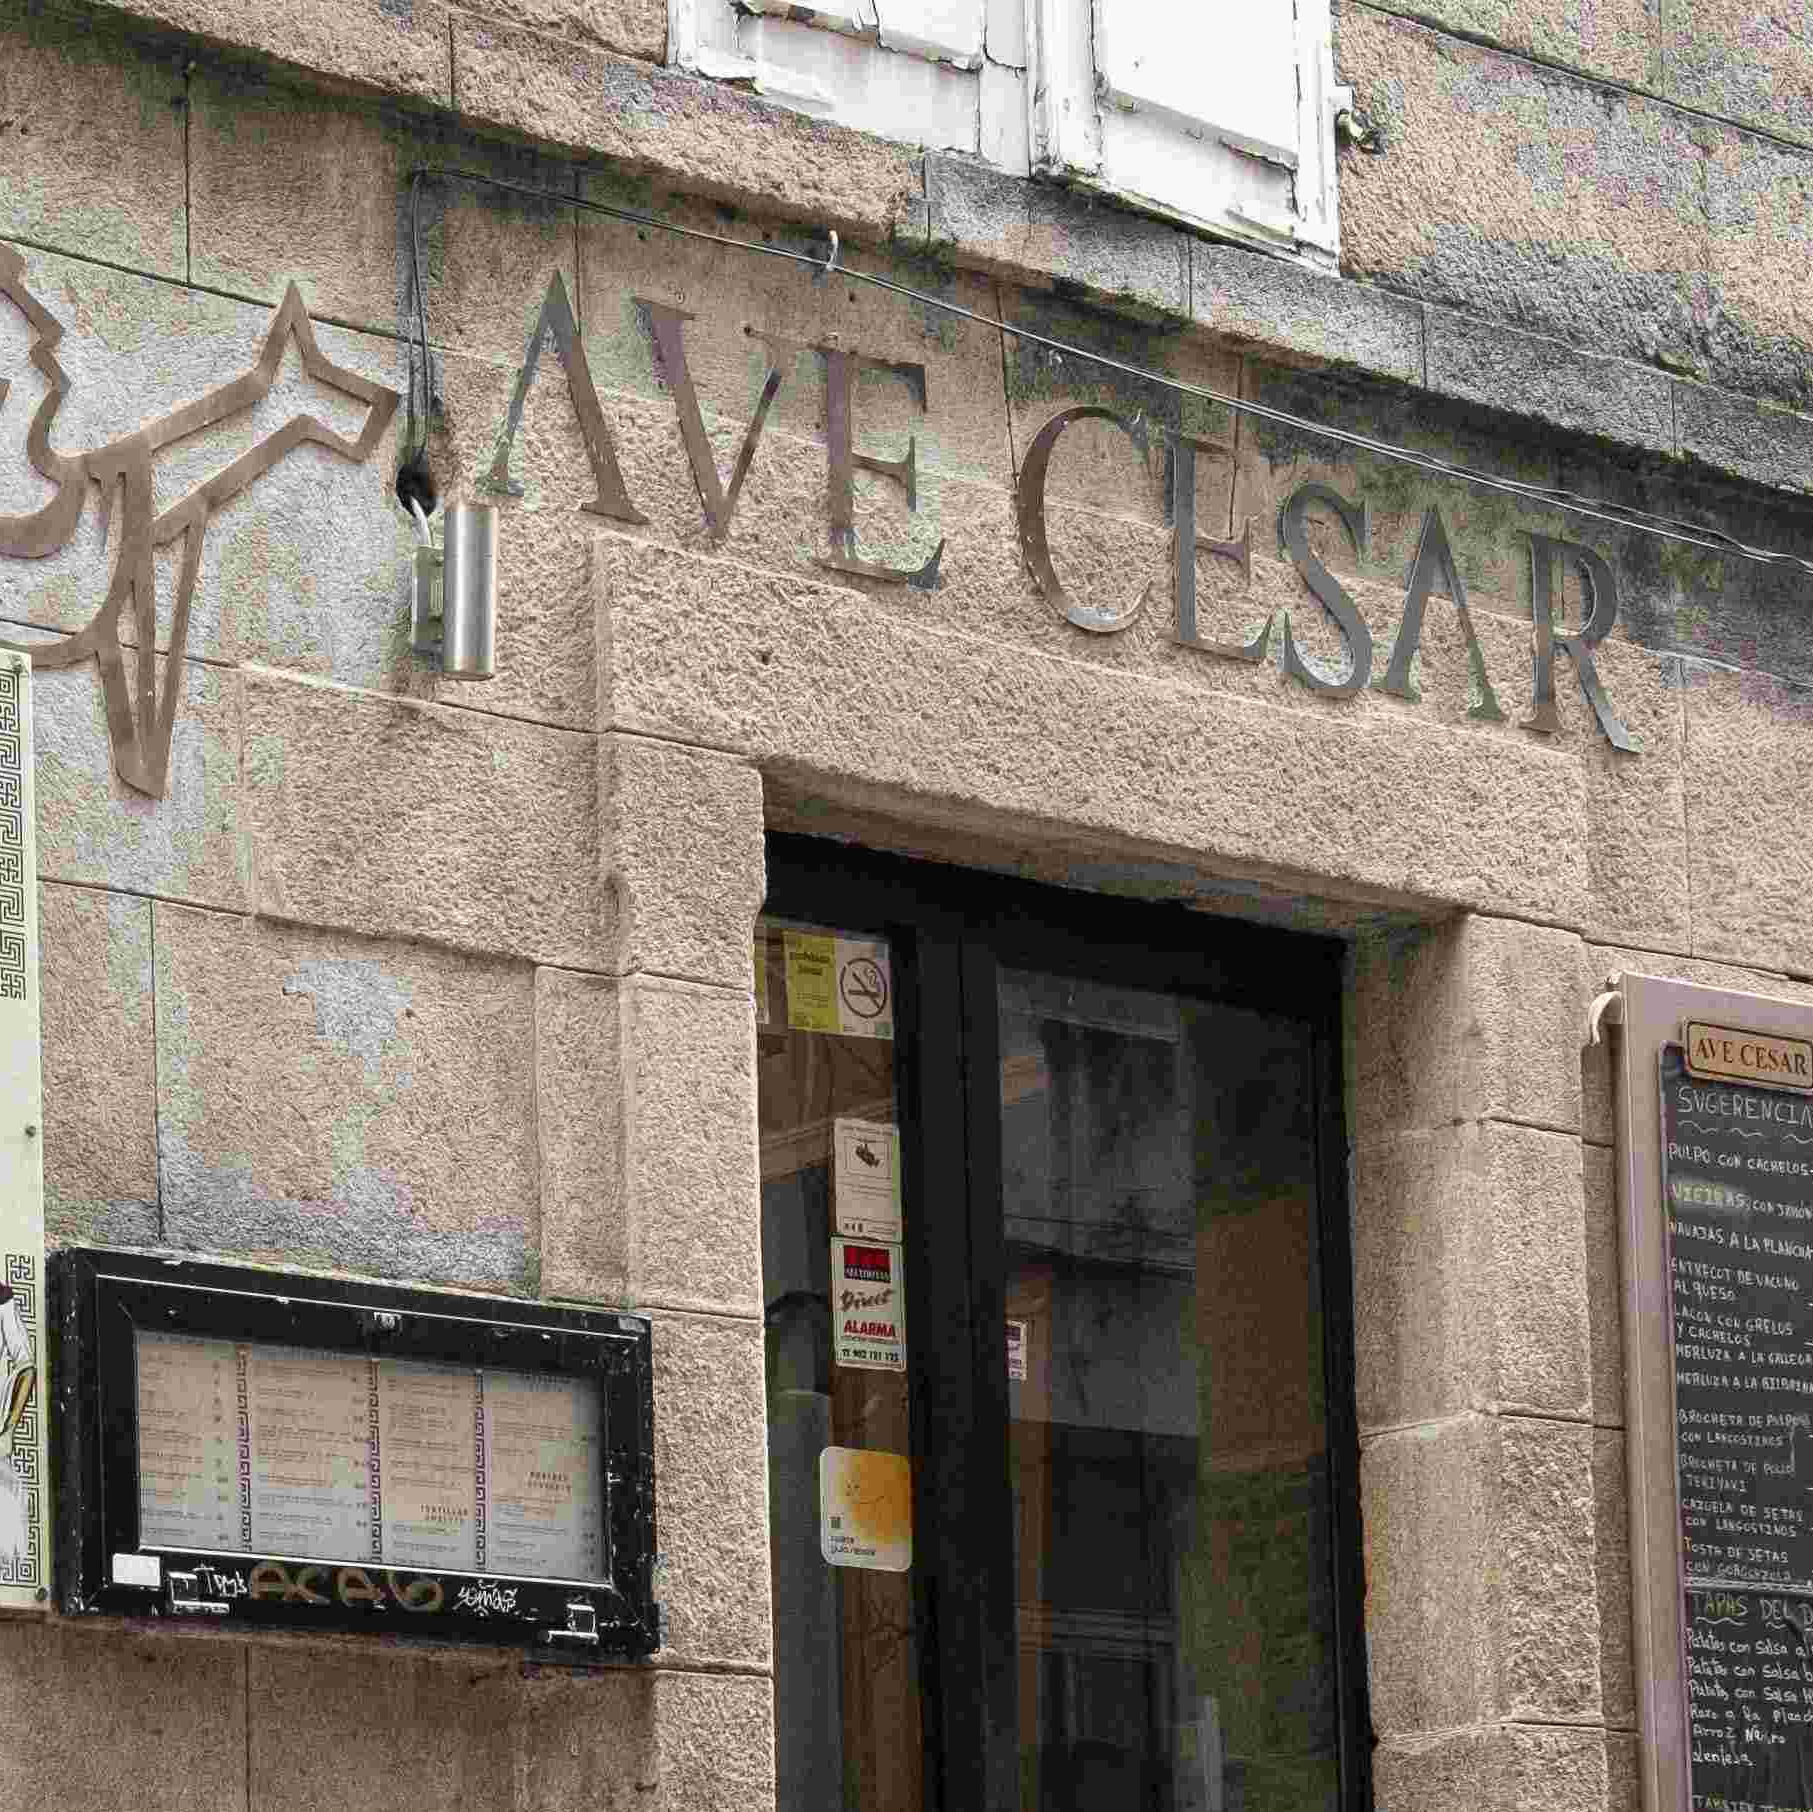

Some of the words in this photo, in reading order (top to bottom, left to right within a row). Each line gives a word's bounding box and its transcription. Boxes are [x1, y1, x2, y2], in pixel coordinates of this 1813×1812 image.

[475, 267, 944, 590] AVE
[1016, 401, 1644, 755] CESAR
[1696, 1038, 1733, 1064] AVE
[1740, 1043, 1807, 1075] CESAR
[1668, 1142, 1710, 1164] PULPO
[1717, 1154, 1741, 1168] CON
[1729, 1232, 1739, 1248] A
[1744, 1235, 1761, 1253] LA
[1738, 1270, 1755, 1285] DE
[844, 1319, 896, 1337] ALARMA
[1760, 1599, 1789, 1621] DEL
